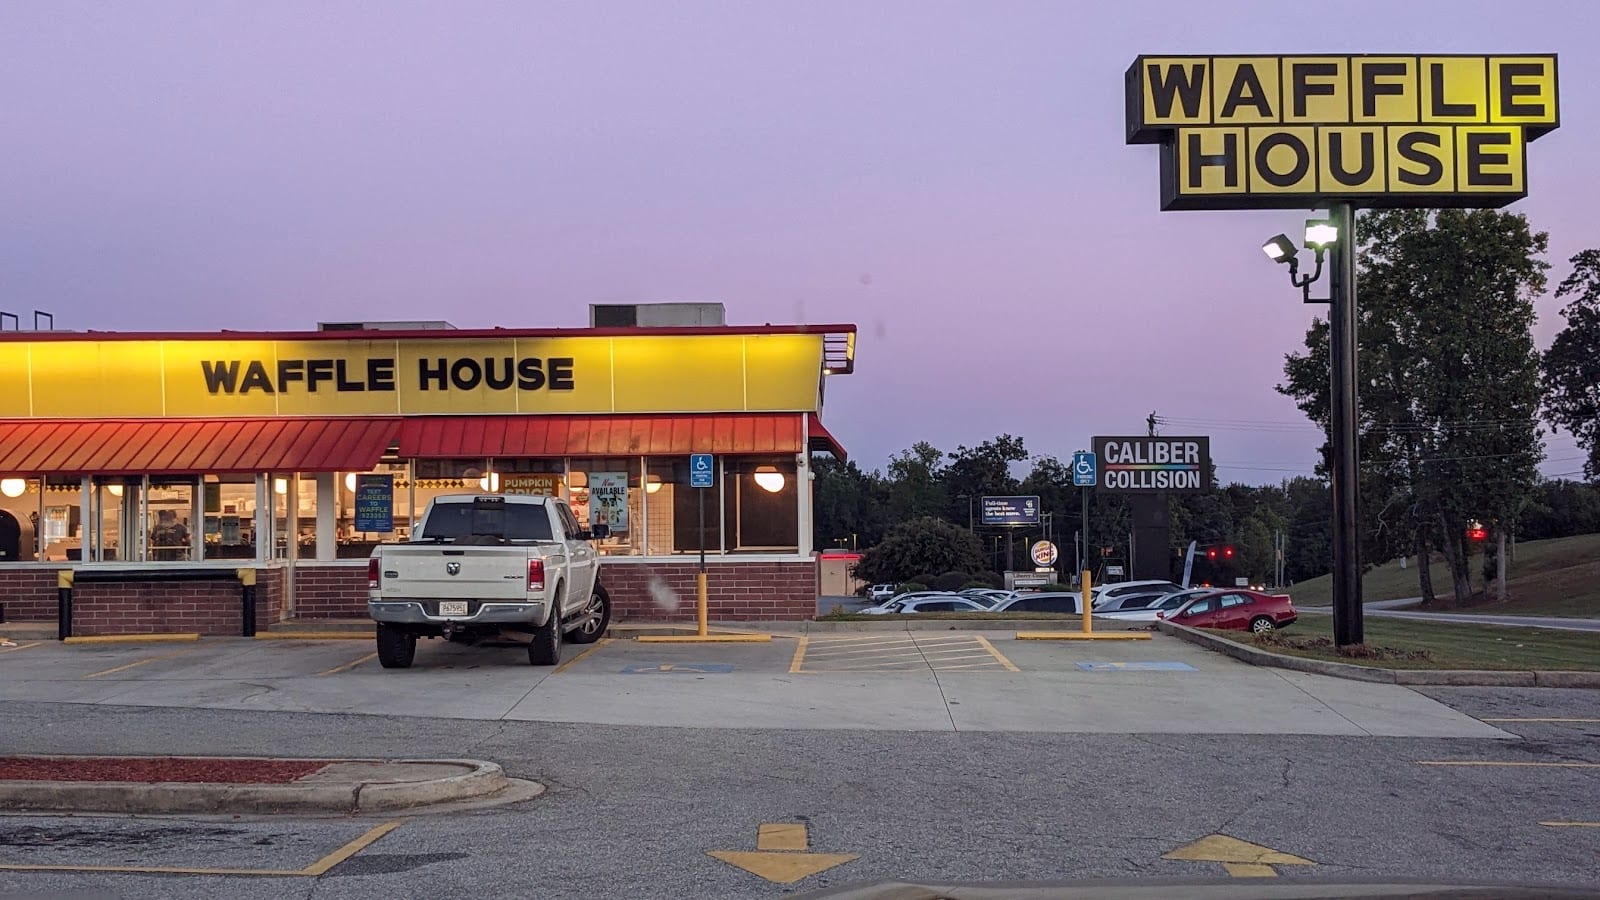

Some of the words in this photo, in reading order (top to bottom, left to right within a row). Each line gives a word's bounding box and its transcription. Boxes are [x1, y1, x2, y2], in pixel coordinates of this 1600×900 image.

[1147, 63, 1546, 118] WAFFLE
[1188, 131, 1513, 187] HOUSE
[201, 357, 395, 394] WAFFLE
[419, 357, 575, 391] HOUSE
[1104, 441, 1200, 464] CALIBER
[504, 479, 553, 488] PUMPKIN
[1104, 470, 1200, 489] COLLISION
[591, 487, 625, 495] AVAILABLE
[1036, 551, 1054, 560] KING
